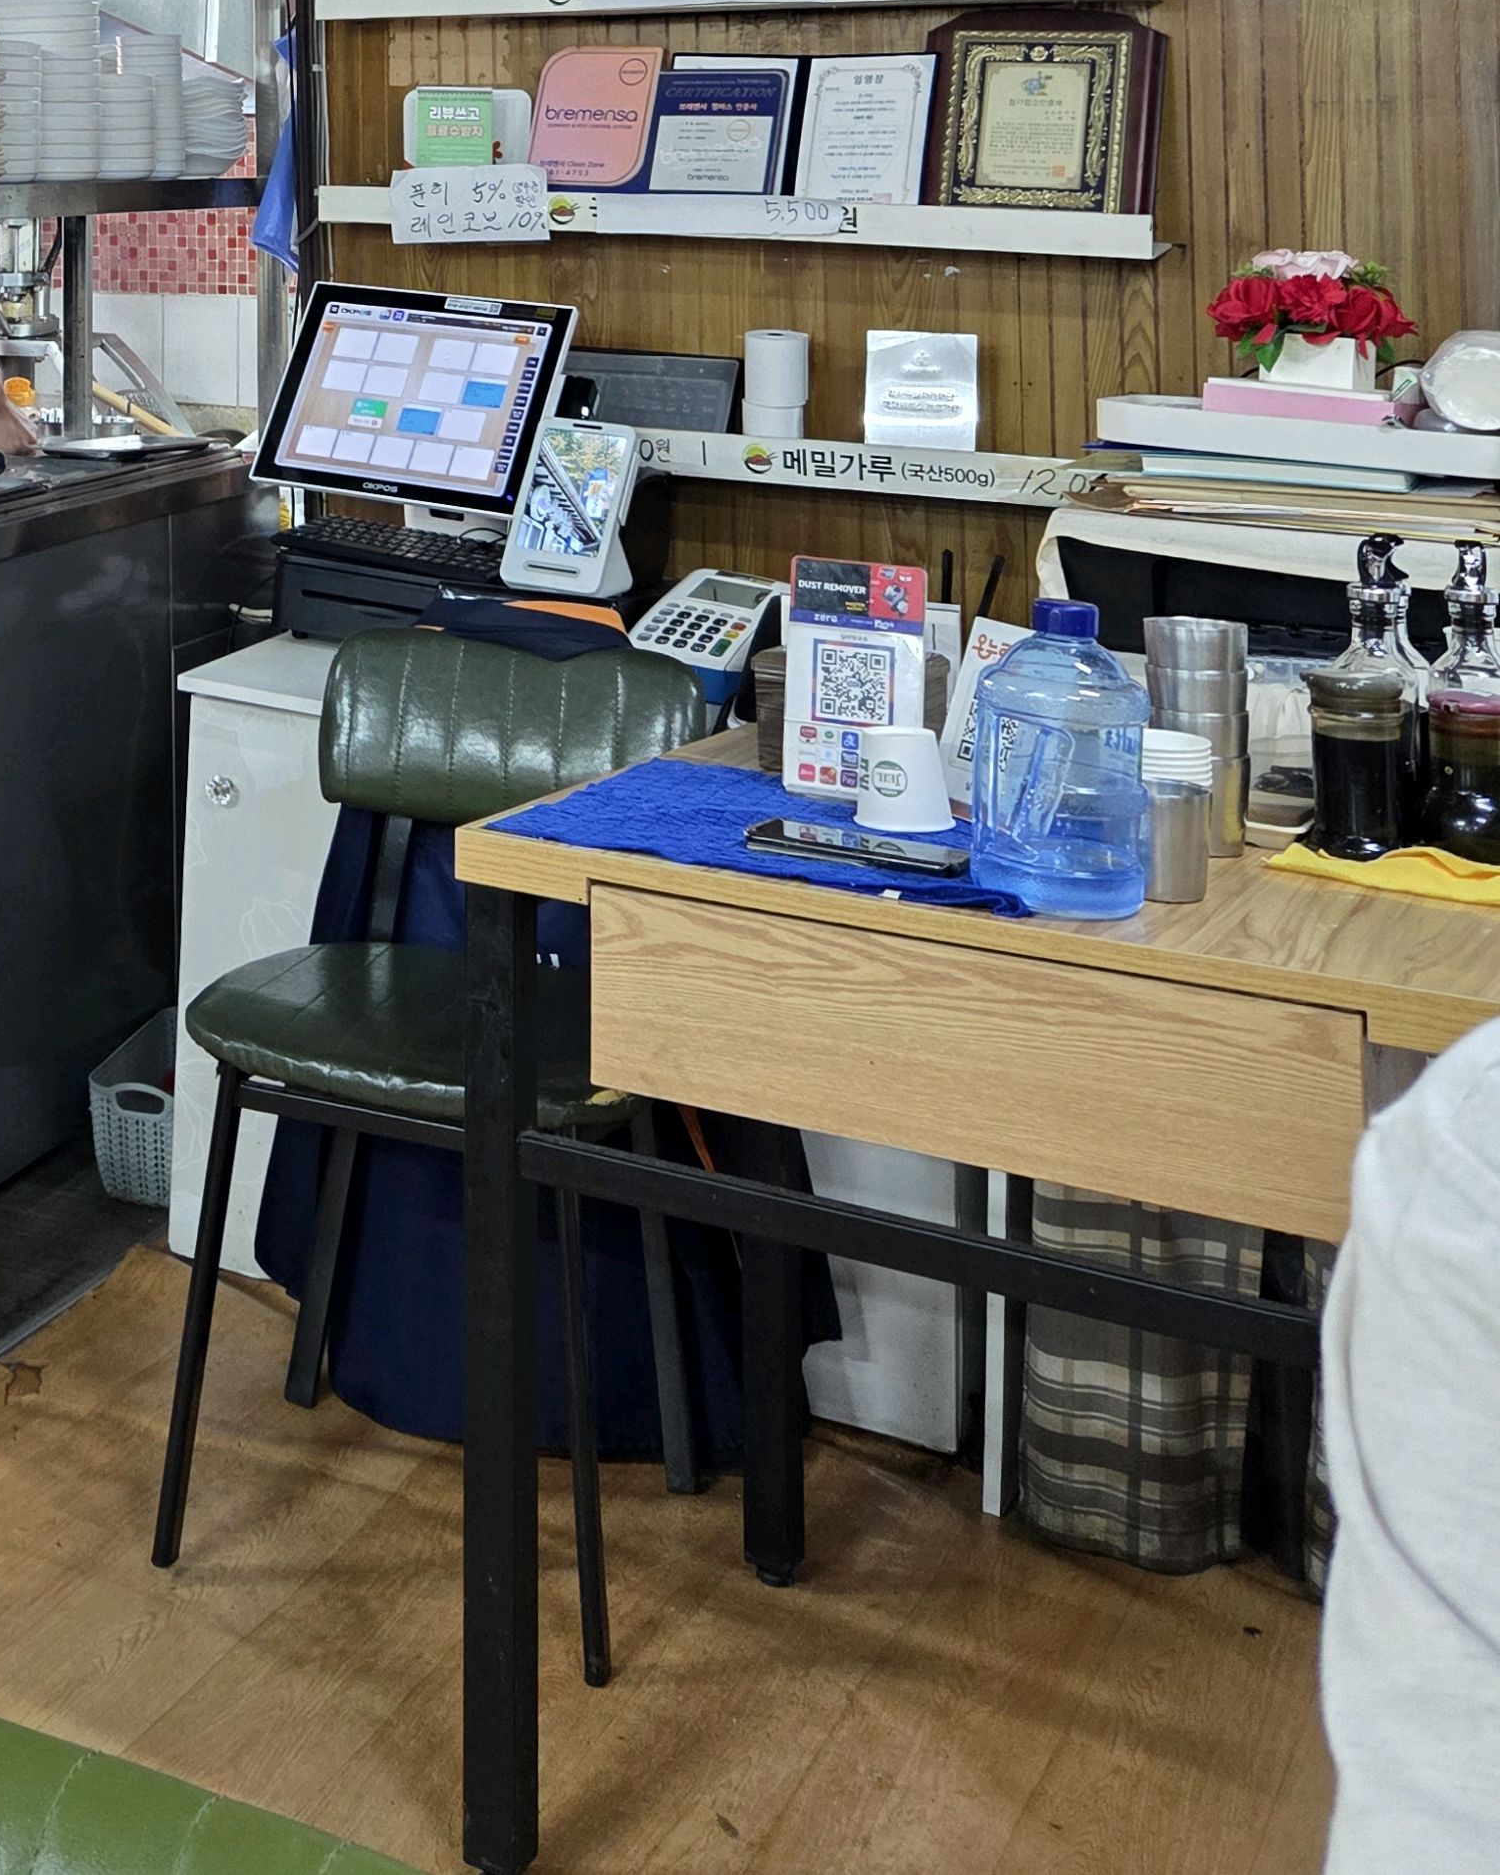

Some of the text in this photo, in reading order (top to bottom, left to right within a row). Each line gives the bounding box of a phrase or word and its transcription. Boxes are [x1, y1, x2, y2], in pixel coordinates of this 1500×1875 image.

[666, 87, 777, 98] CERTIFICATION
[430, 106, 480, 121] 리뷰쓰고
[545, 105, 638, 122] bremensa
[472, 180, 506, 203] 5%
[782, 449, 896, 483] 메밀가루
[901, 461, 995, 488] (국산500g)
[363, 481, 398, 493] OKPOS
[798, 580, 867, 595] DUST REMOVER
[814, 613, 838, 623] zero
